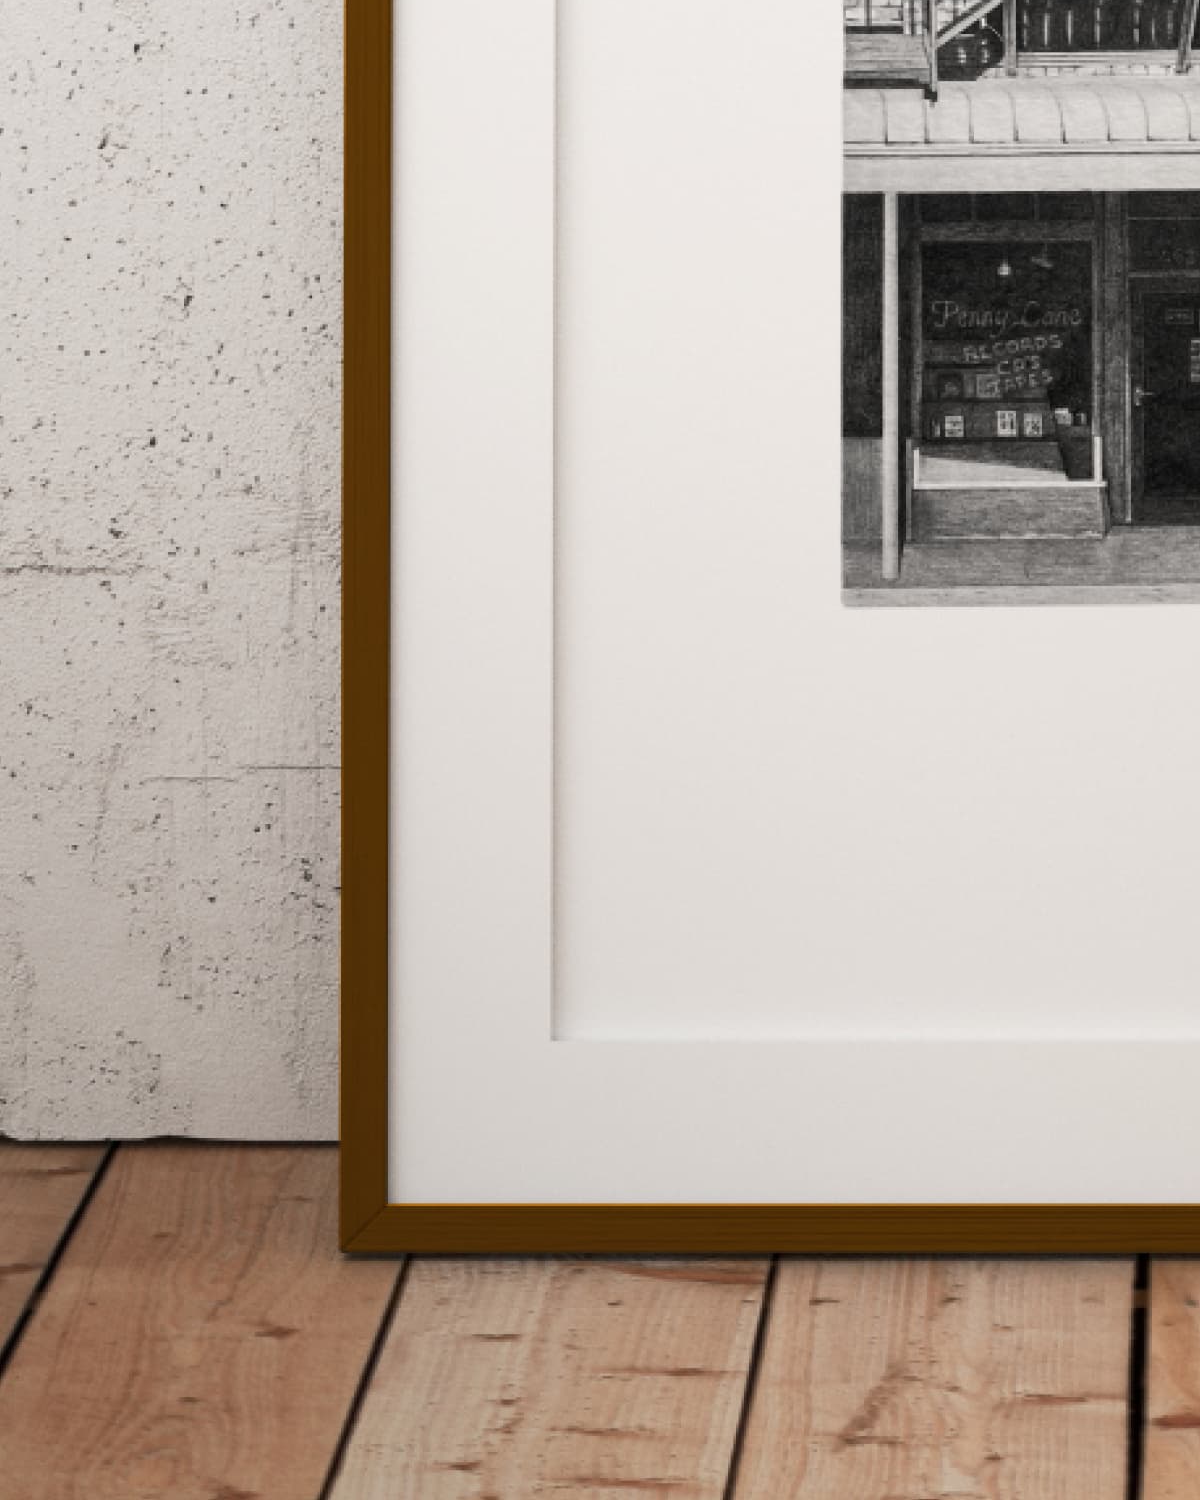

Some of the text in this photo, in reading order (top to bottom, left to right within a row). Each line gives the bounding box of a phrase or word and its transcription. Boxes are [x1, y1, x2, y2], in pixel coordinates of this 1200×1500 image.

[931, 300, 1009, 338] Penny
[962, 334, 1063, 362] RECORDS
[986, 369, 1053, 394] TAPES
